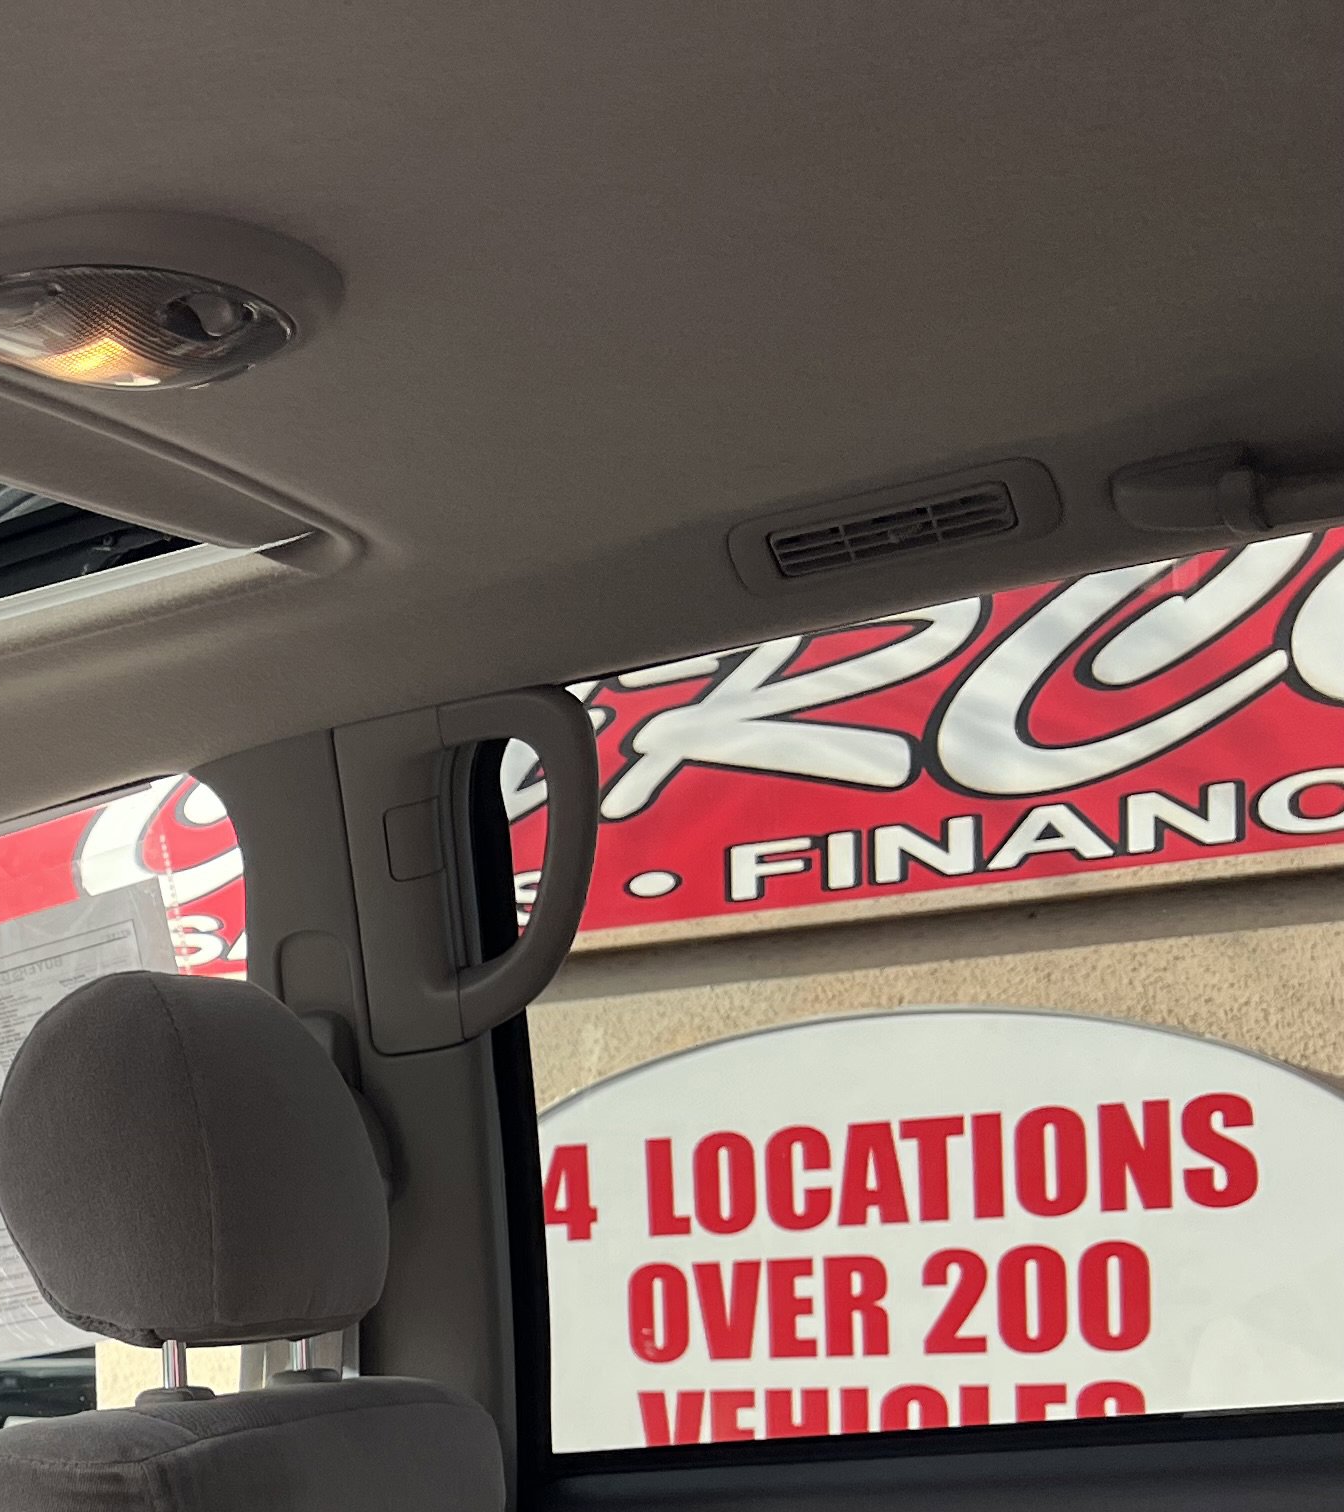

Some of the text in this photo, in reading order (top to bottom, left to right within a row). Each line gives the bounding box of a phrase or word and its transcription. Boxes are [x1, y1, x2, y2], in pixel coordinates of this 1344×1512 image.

[542, 1093, 1259, 1241] 4 LOCATIONS
[627, 1241, 1151, 1364] OVER 200
